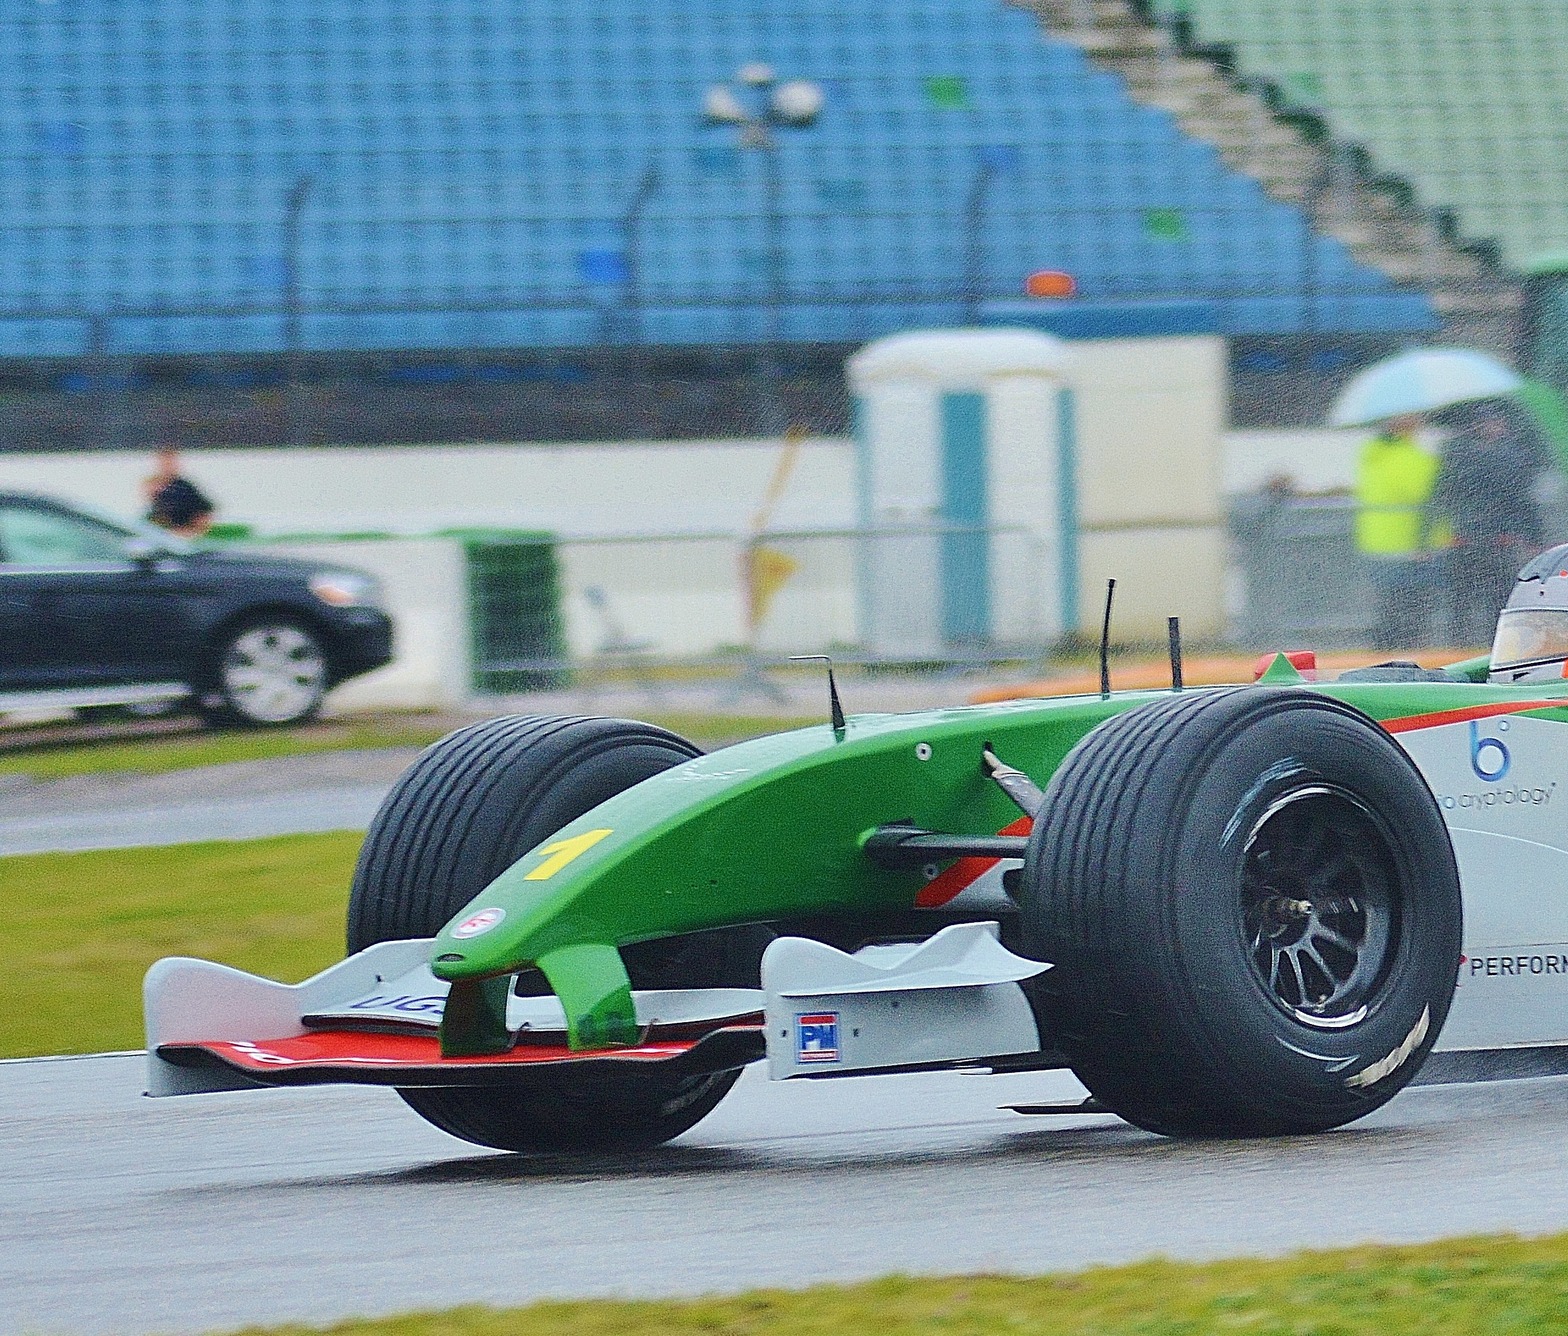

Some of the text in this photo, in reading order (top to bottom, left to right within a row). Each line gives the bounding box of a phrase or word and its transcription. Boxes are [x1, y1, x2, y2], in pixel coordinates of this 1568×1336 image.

[523, 829, 615, 881] 1
[350, 995, 450, 1015] UG
[801, 1024, 838, 1051] PM
